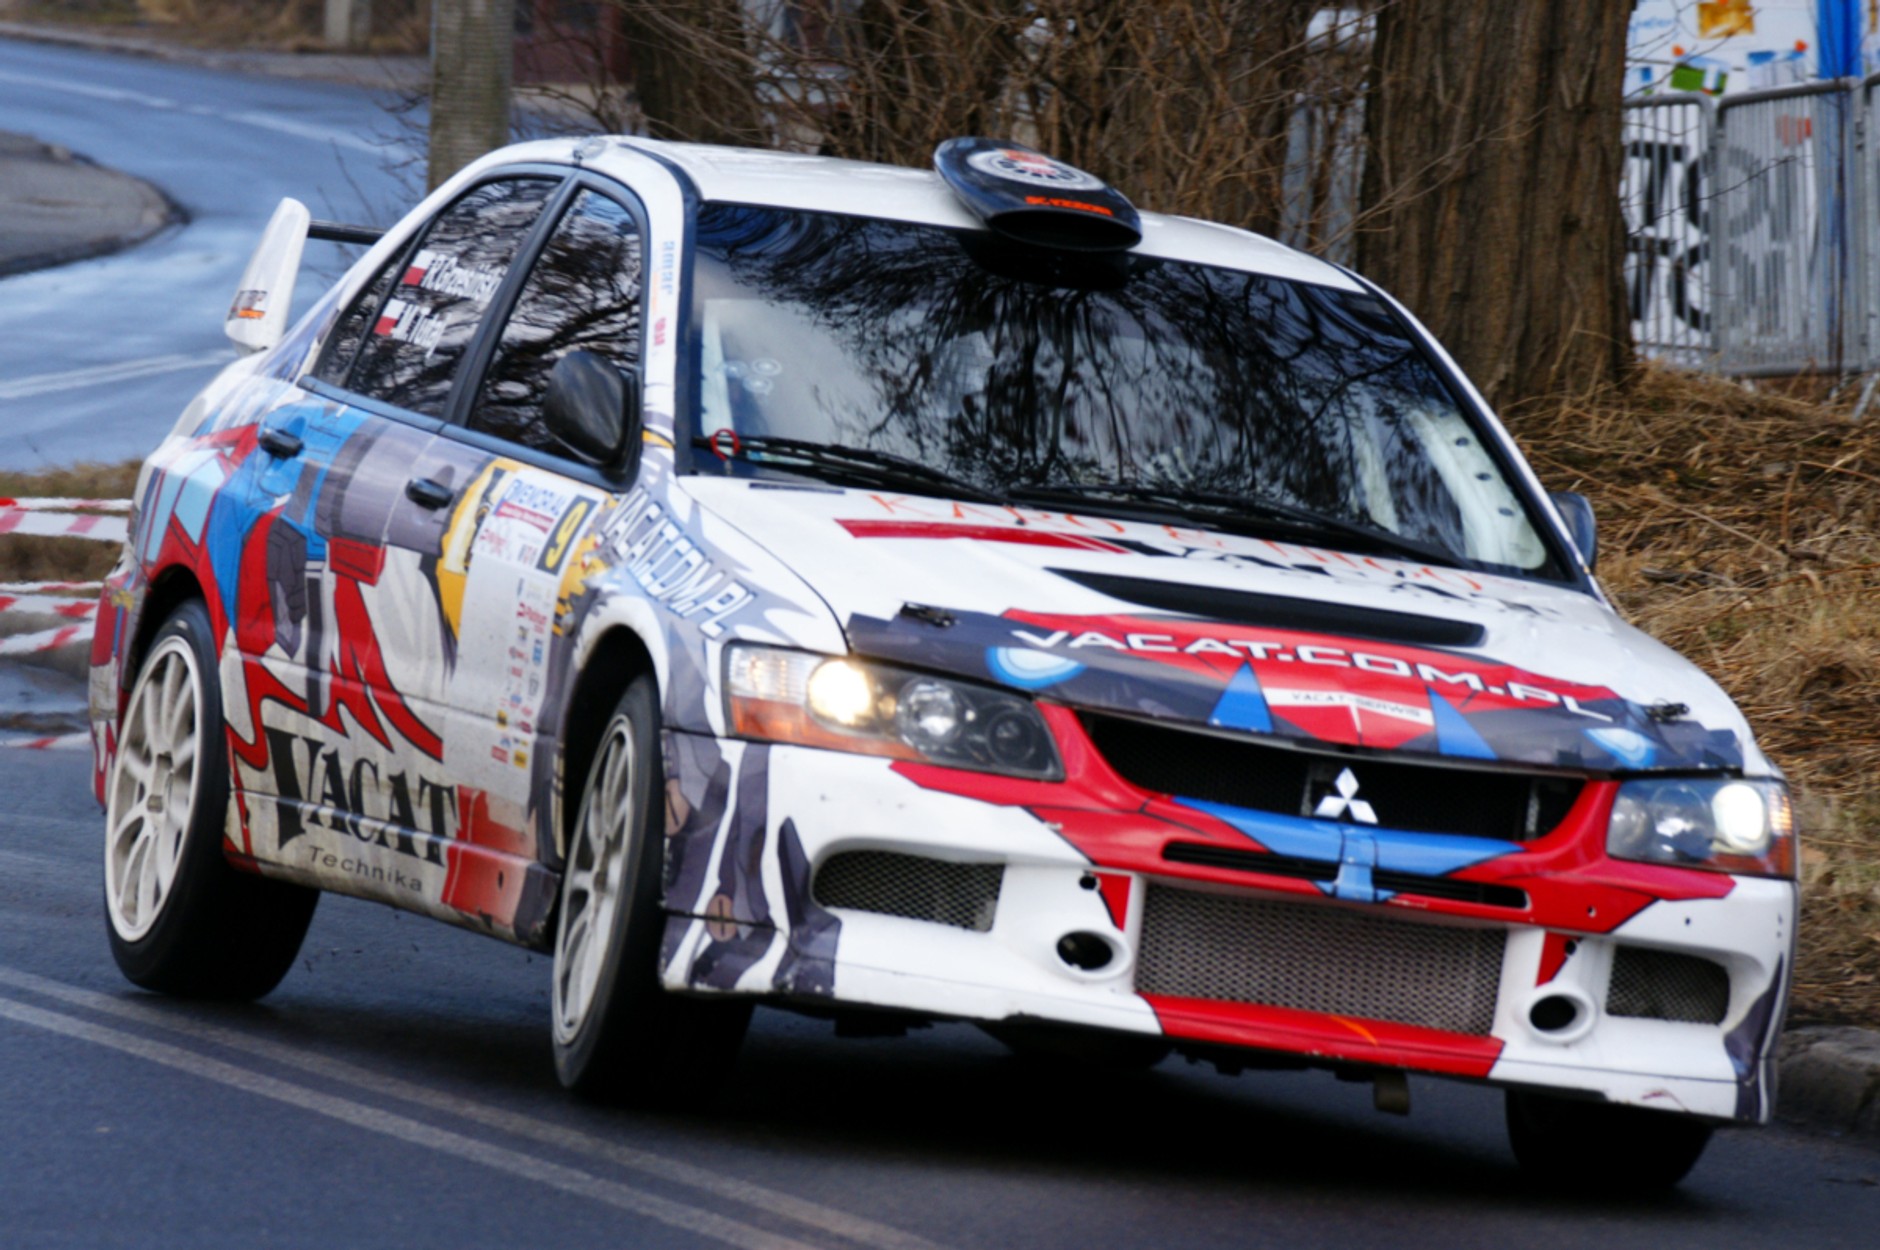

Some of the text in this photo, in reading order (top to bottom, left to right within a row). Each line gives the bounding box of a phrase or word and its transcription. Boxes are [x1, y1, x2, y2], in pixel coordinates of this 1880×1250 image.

[545, 501, 588, 569] 9
[1009, 630, 1614, 723] VACAT.COM.PL
[264, 726, 458, 869] VACAT
[308, 844, 424, 893] Technika
